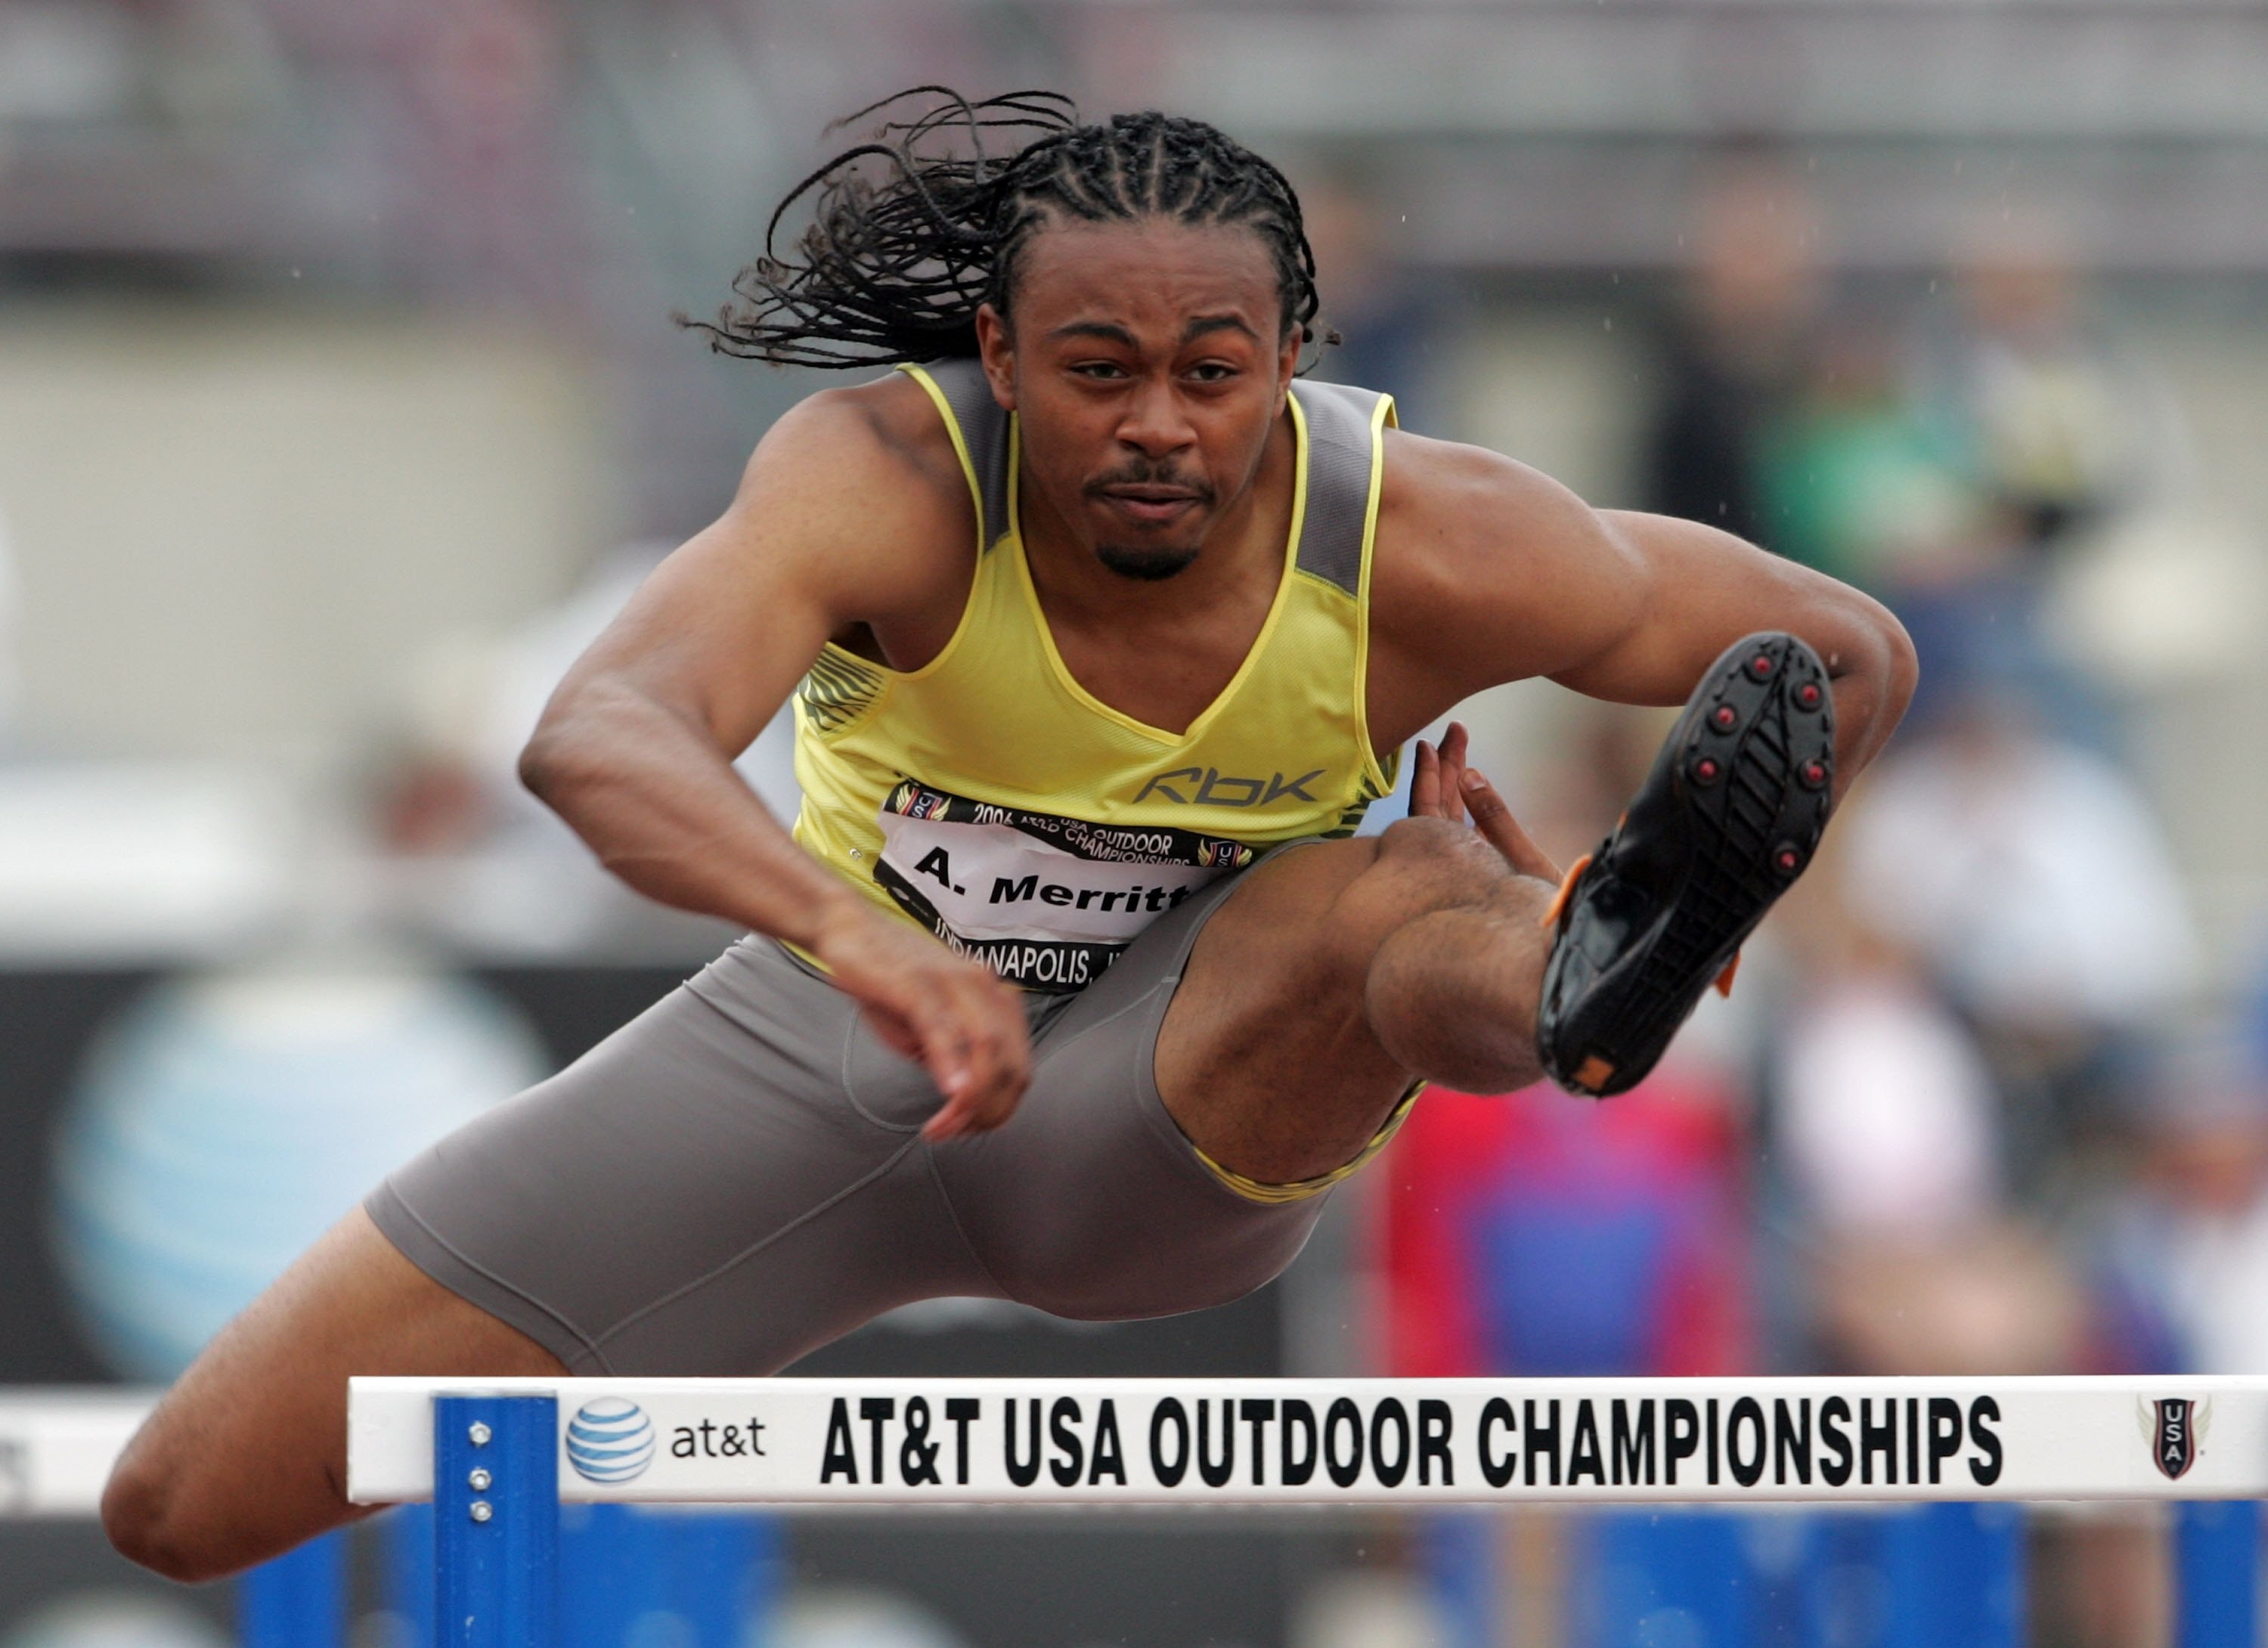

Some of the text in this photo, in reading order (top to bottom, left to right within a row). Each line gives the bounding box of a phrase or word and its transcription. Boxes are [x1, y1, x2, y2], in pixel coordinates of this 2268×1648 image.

[1060, 817, 1088, 833] USA
[1093, 829, 1173, 856] OUTDOOR
[913, 845, 1190, 913] A. Merritt
[671, 1417, 767, 1457] at&t
[820, 1396, 2002, 1488] AT&T USA OUTDOOR CHAMPIONSHIPS
[2164, 1405, 2183, 1461] USA
